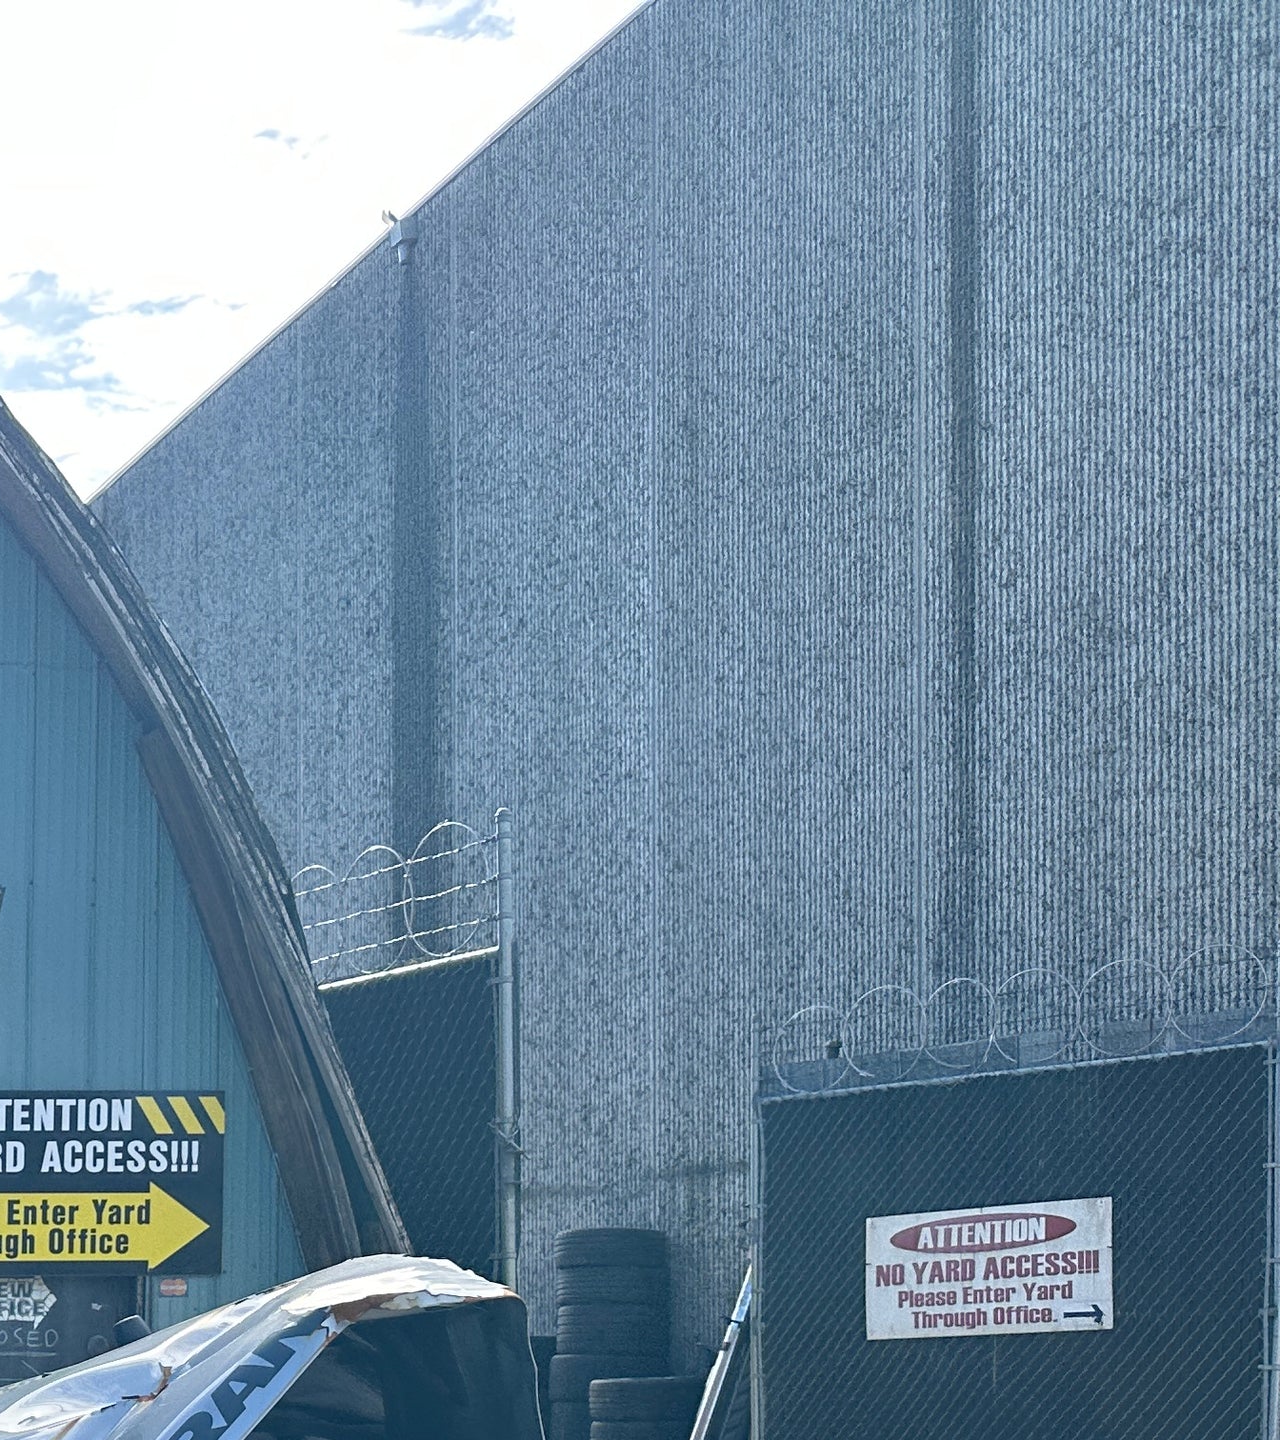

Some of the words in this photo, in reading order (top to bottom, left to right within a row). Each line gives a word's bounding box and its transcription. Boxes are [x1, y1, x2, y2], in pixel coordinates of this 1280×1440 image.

[40, 1139, 200, 1174] ACCESS!!!
[7, 1199, 80, 1226] Enter
[91, 1198, 151, 1225] Yard
[48, 1228, 130, 1256] Office
[917, 1217, 1046, 1250] ATTENTION
[875, 1263, 906, 1288] NO
[912, 1259, 976, 1285] YARD
[982, 1249, 1101, 1281] ACCESS!!!
[897, 1288, 958, 1309] Please
[963, 1284, 1017, 1305] Enter
[1022, 1281, 1074, 1301] Yard
[911, 1307, 989, 1330] Through
[993, 1305, 1059, 1326] Office.
